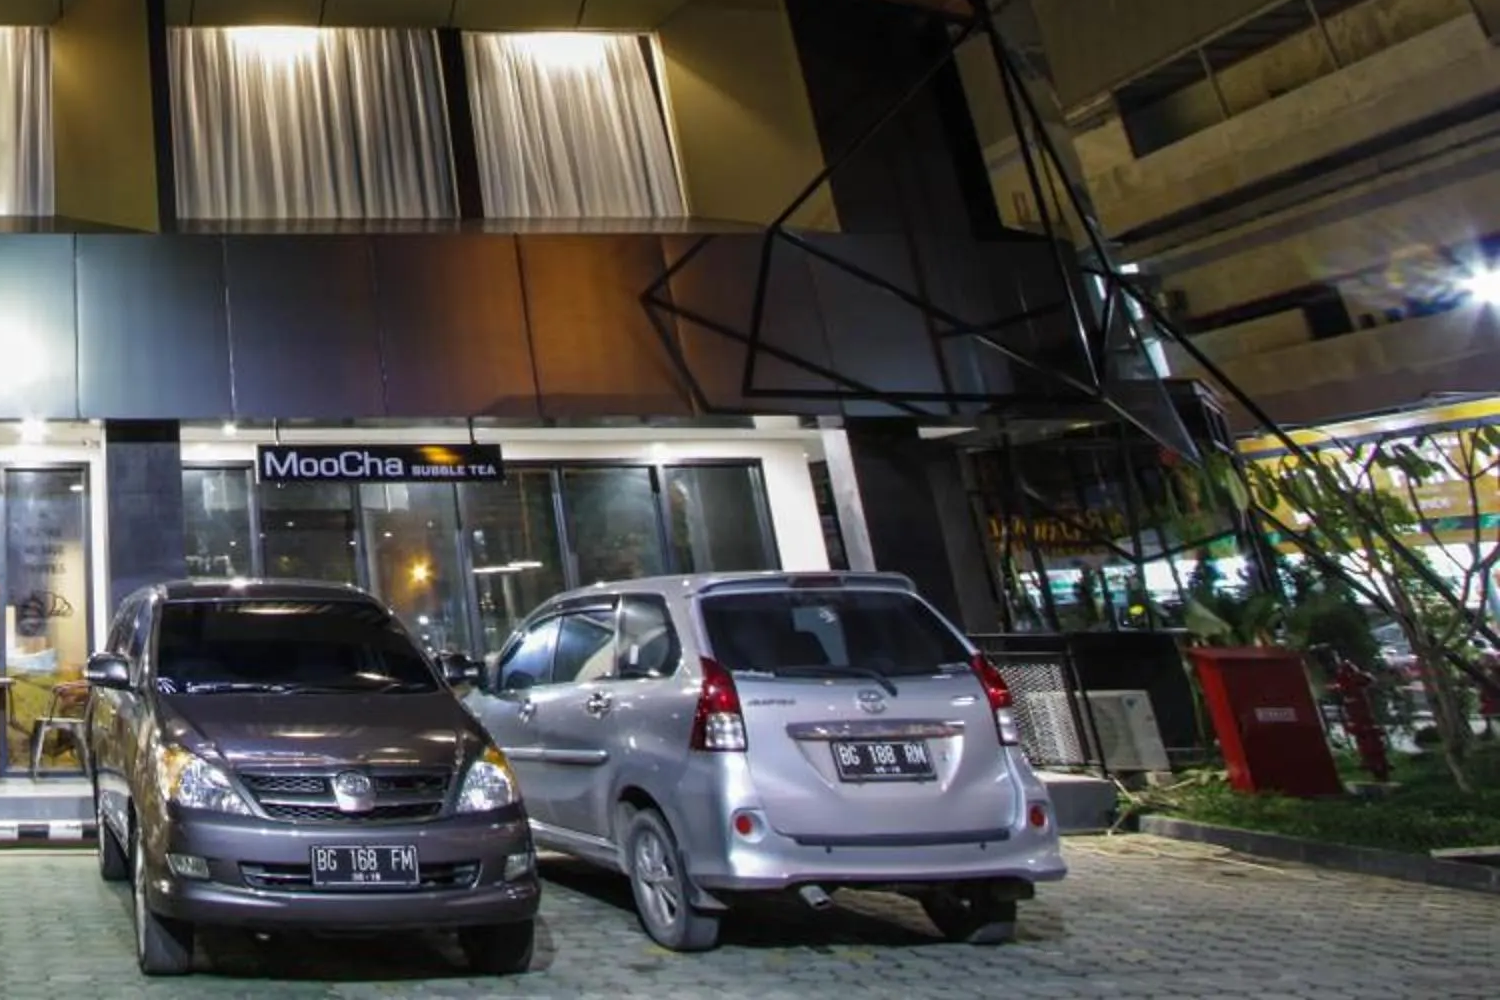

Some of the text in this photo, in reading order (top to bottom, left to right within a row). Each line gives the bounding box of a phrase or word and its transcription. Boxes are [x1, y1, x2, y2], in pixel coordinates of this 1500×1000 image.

[264, 452, 497, 477] MooCha BUBBLE TEA
[840, 745, 861, 765] BG
[868, 745, 897, 764] 188
[317, 849, 414, 871] BG 168 FM
